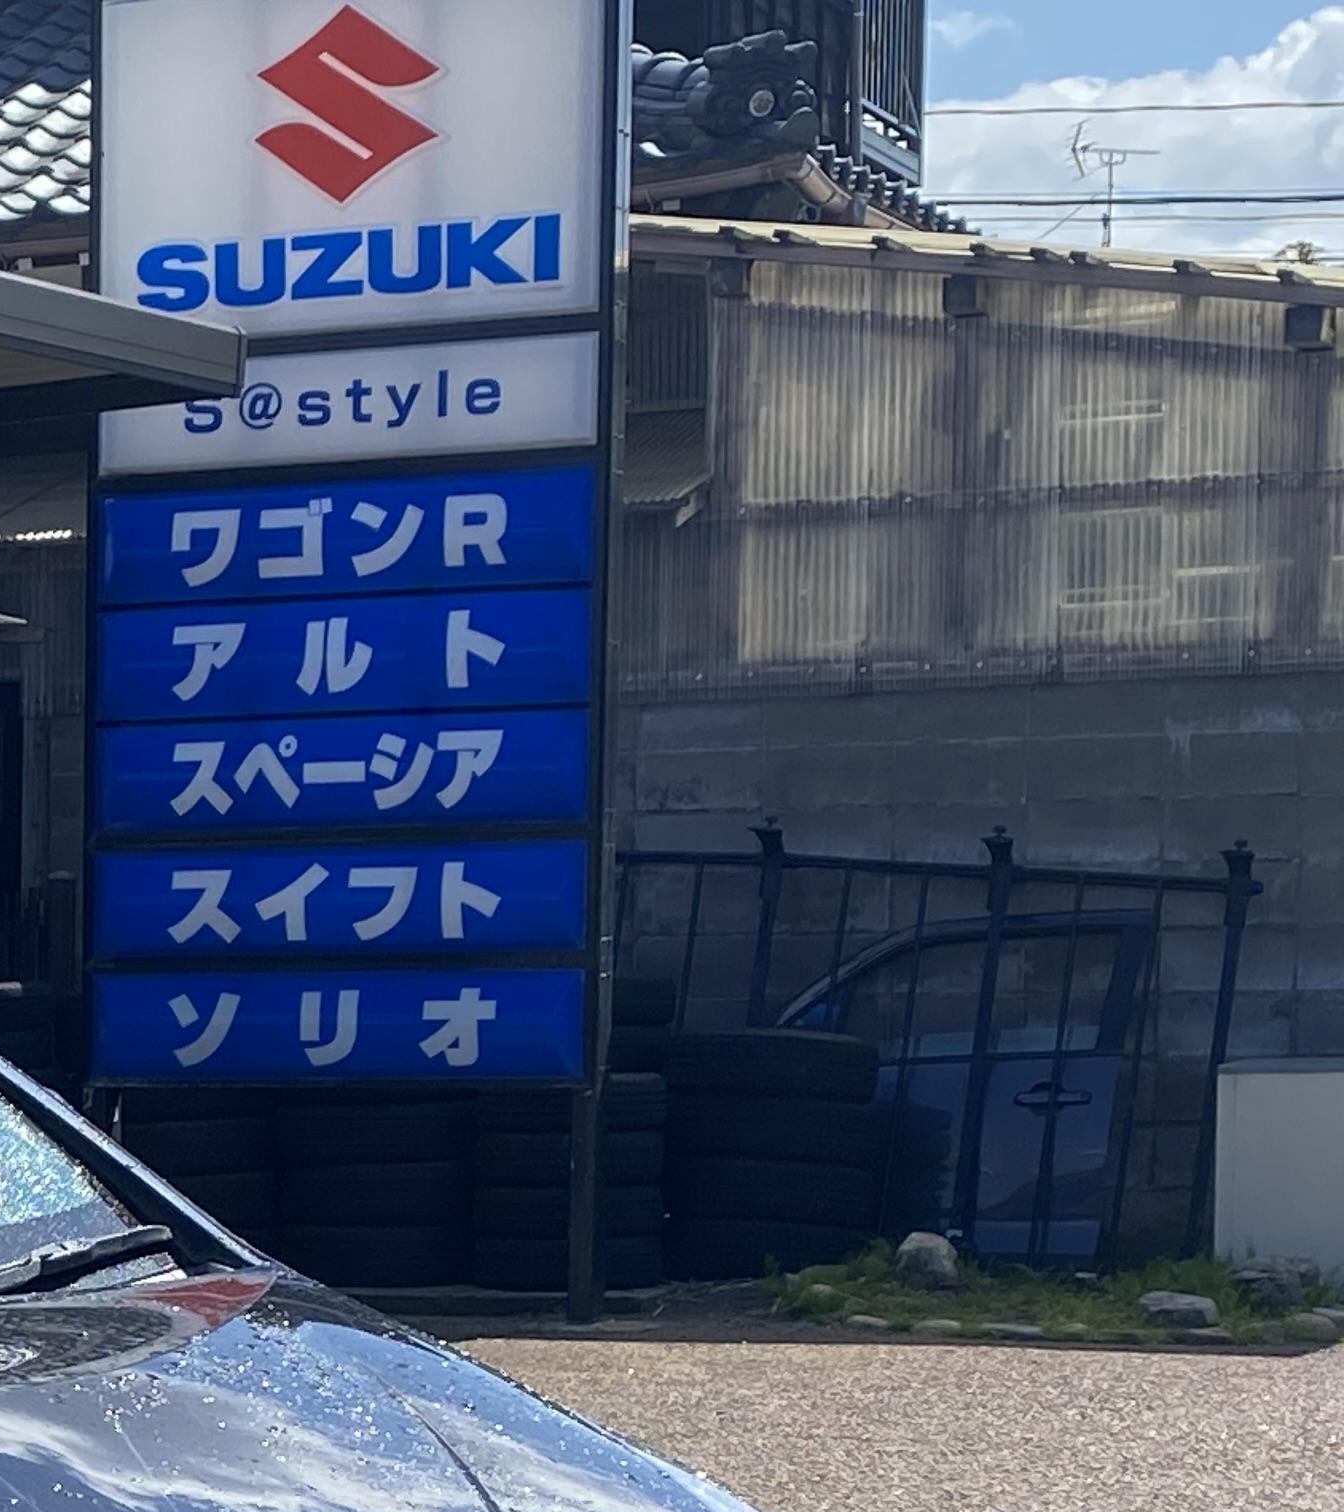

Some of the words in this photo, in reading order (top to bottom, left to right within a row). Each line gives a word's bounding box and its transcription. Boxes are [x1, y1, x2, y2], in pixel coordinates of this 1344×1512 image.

[136, 213, 561, 312] SUZUKI
[183, 369, 502, 433] s@style
[170, 493, 508, 588] ワゴンR
[170, 609, 506, 702] アルト
[169, 729, 504, 816] スペーシア
[167, 861, 502, 944] スイフト
[167, 986, 497, 1068] ソリオ
